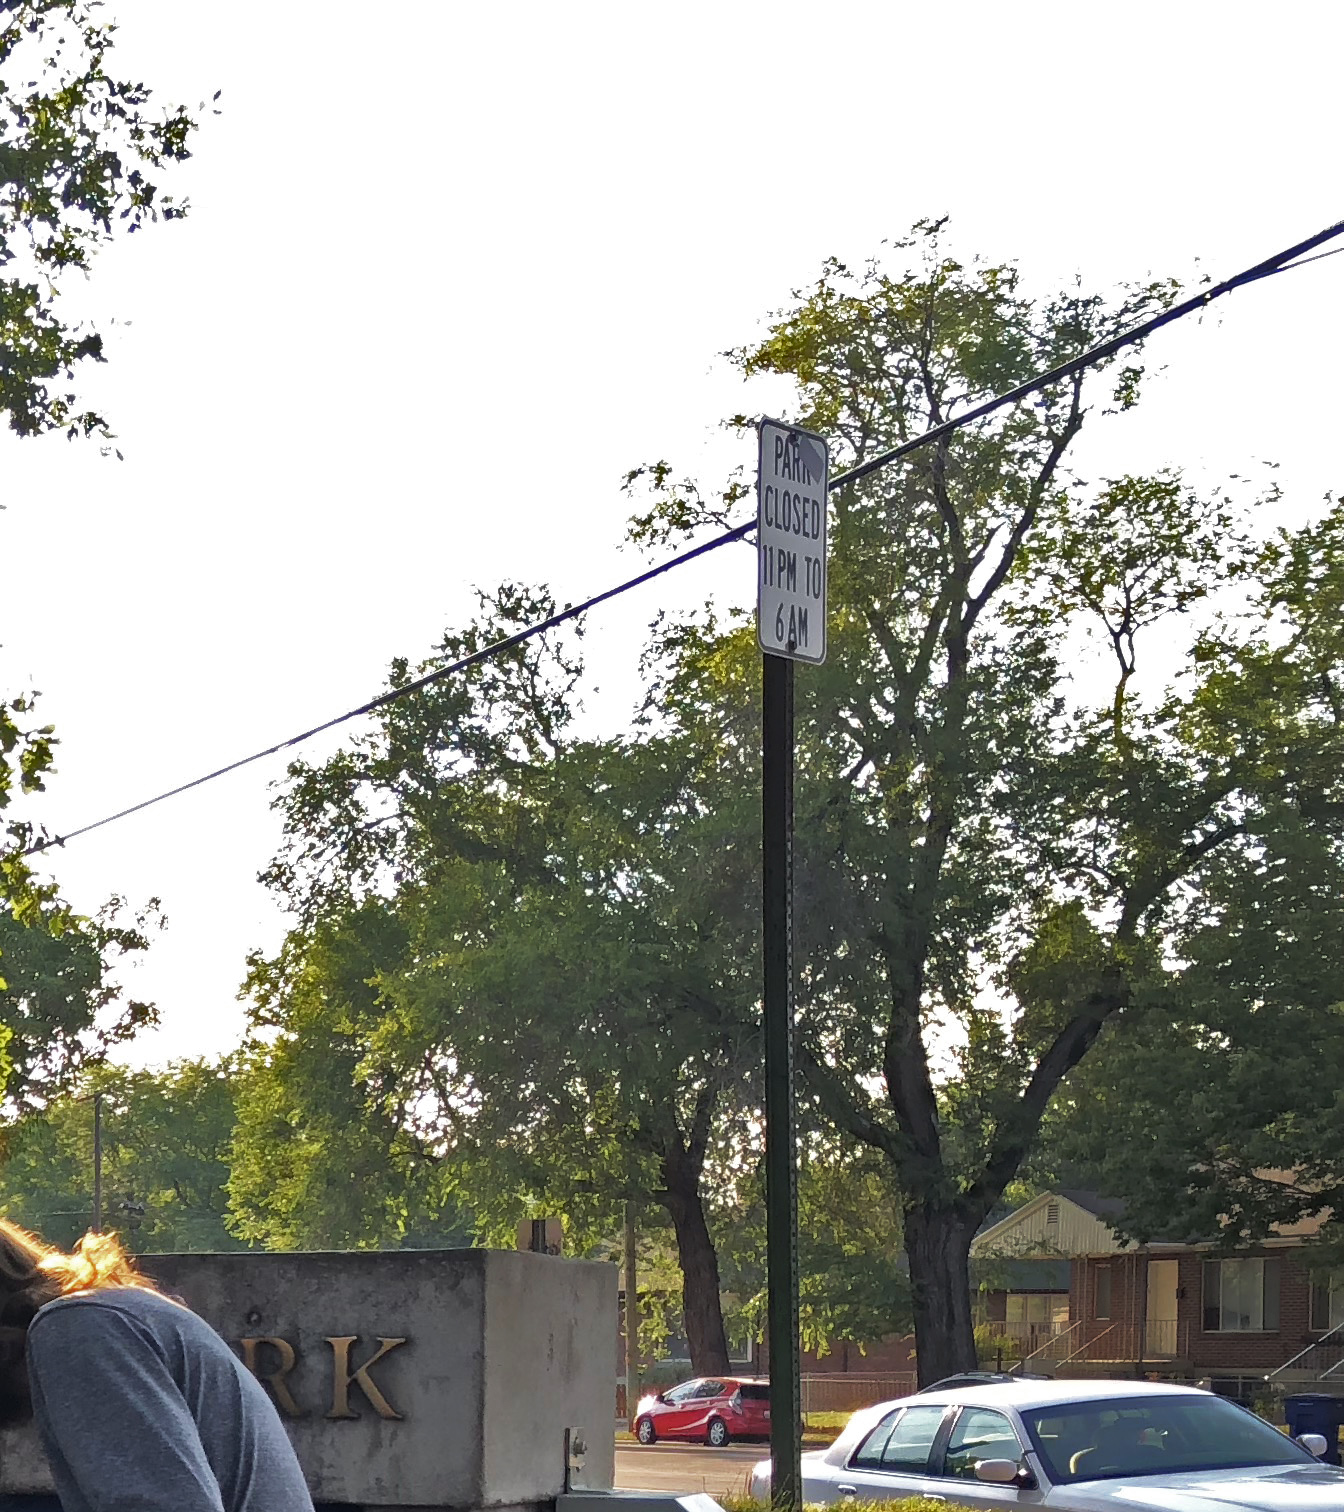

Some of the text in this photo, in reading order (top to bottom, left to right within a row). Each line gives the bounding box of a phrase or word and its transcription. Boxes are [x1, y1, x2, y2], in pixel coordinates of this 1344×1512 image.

[765, 485, 820, 540] CLOSED
[805, 556, 821, 600] TO
[236, 1335, 407, 1420] RK
